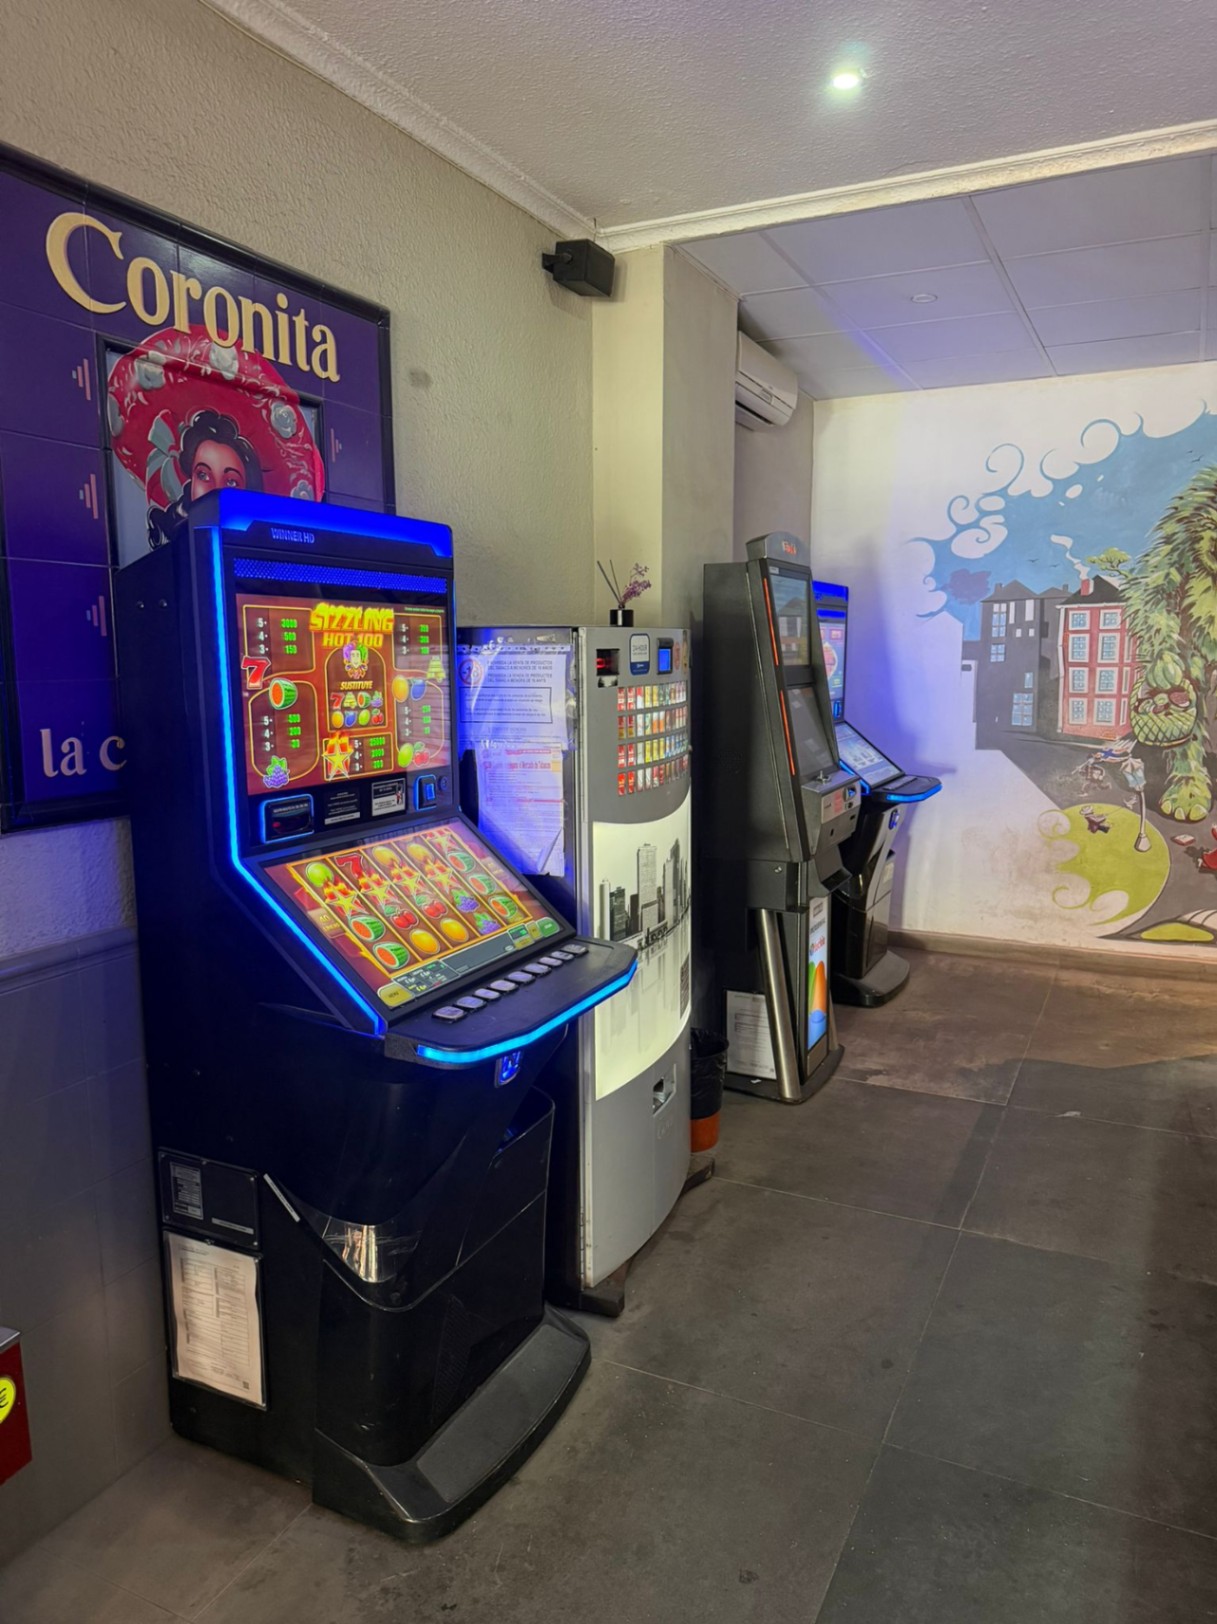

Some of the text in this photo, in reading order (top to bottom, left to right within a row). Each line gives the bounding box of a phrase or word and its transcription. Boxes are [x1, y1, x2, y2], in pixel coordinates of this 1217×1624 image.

[46, 212, 340, 383] Coronita
[271, 527, 315, 544] WINNER HD
[309, 602, 395, 634] SIZZLING
[323, 632, 384, 649] HOT 100
[40, 728, 87, 778] la
